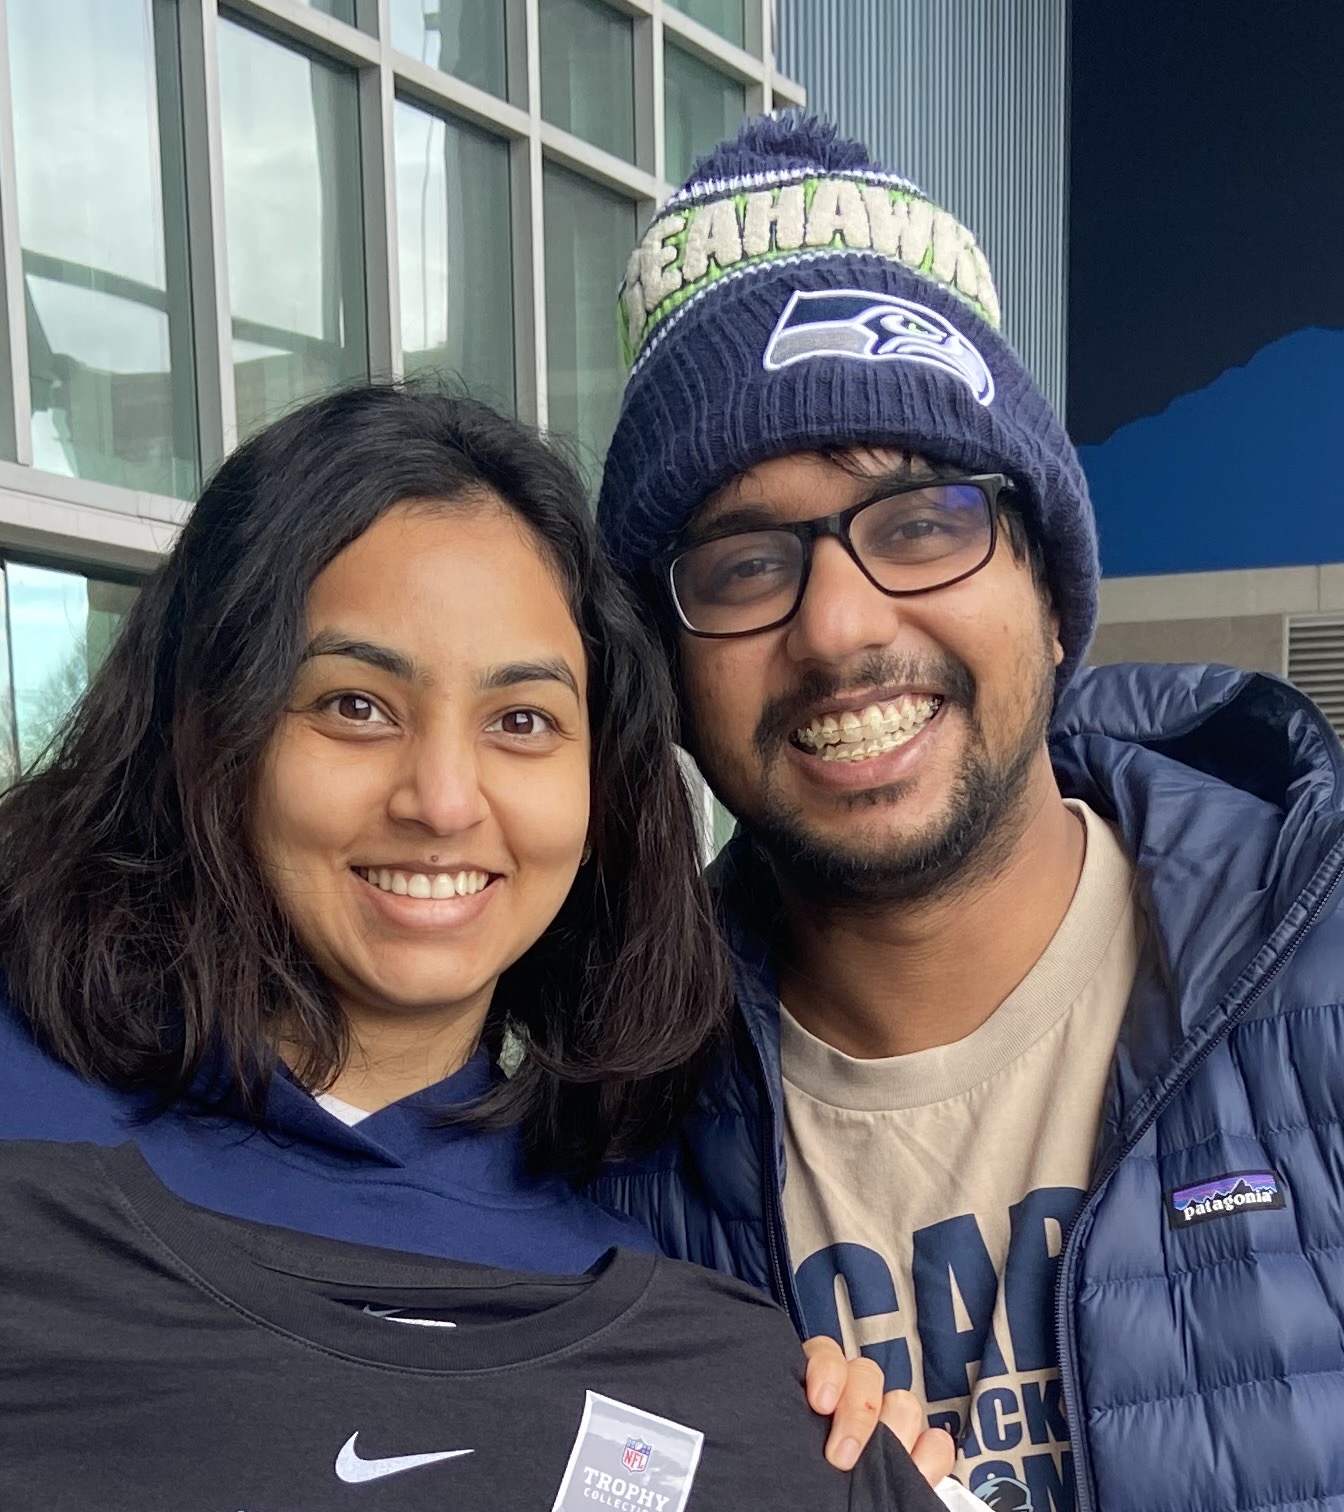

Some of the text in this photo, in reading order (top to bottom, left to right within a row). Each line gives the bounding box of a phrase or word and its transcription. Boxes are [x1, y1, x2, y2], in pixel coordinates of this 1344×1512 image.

[1183, 1190, 1273, 1221] patagonia
[624, 1449, 645, 1470] NFL
[584, 1466, 670, 1512] TROPHY
